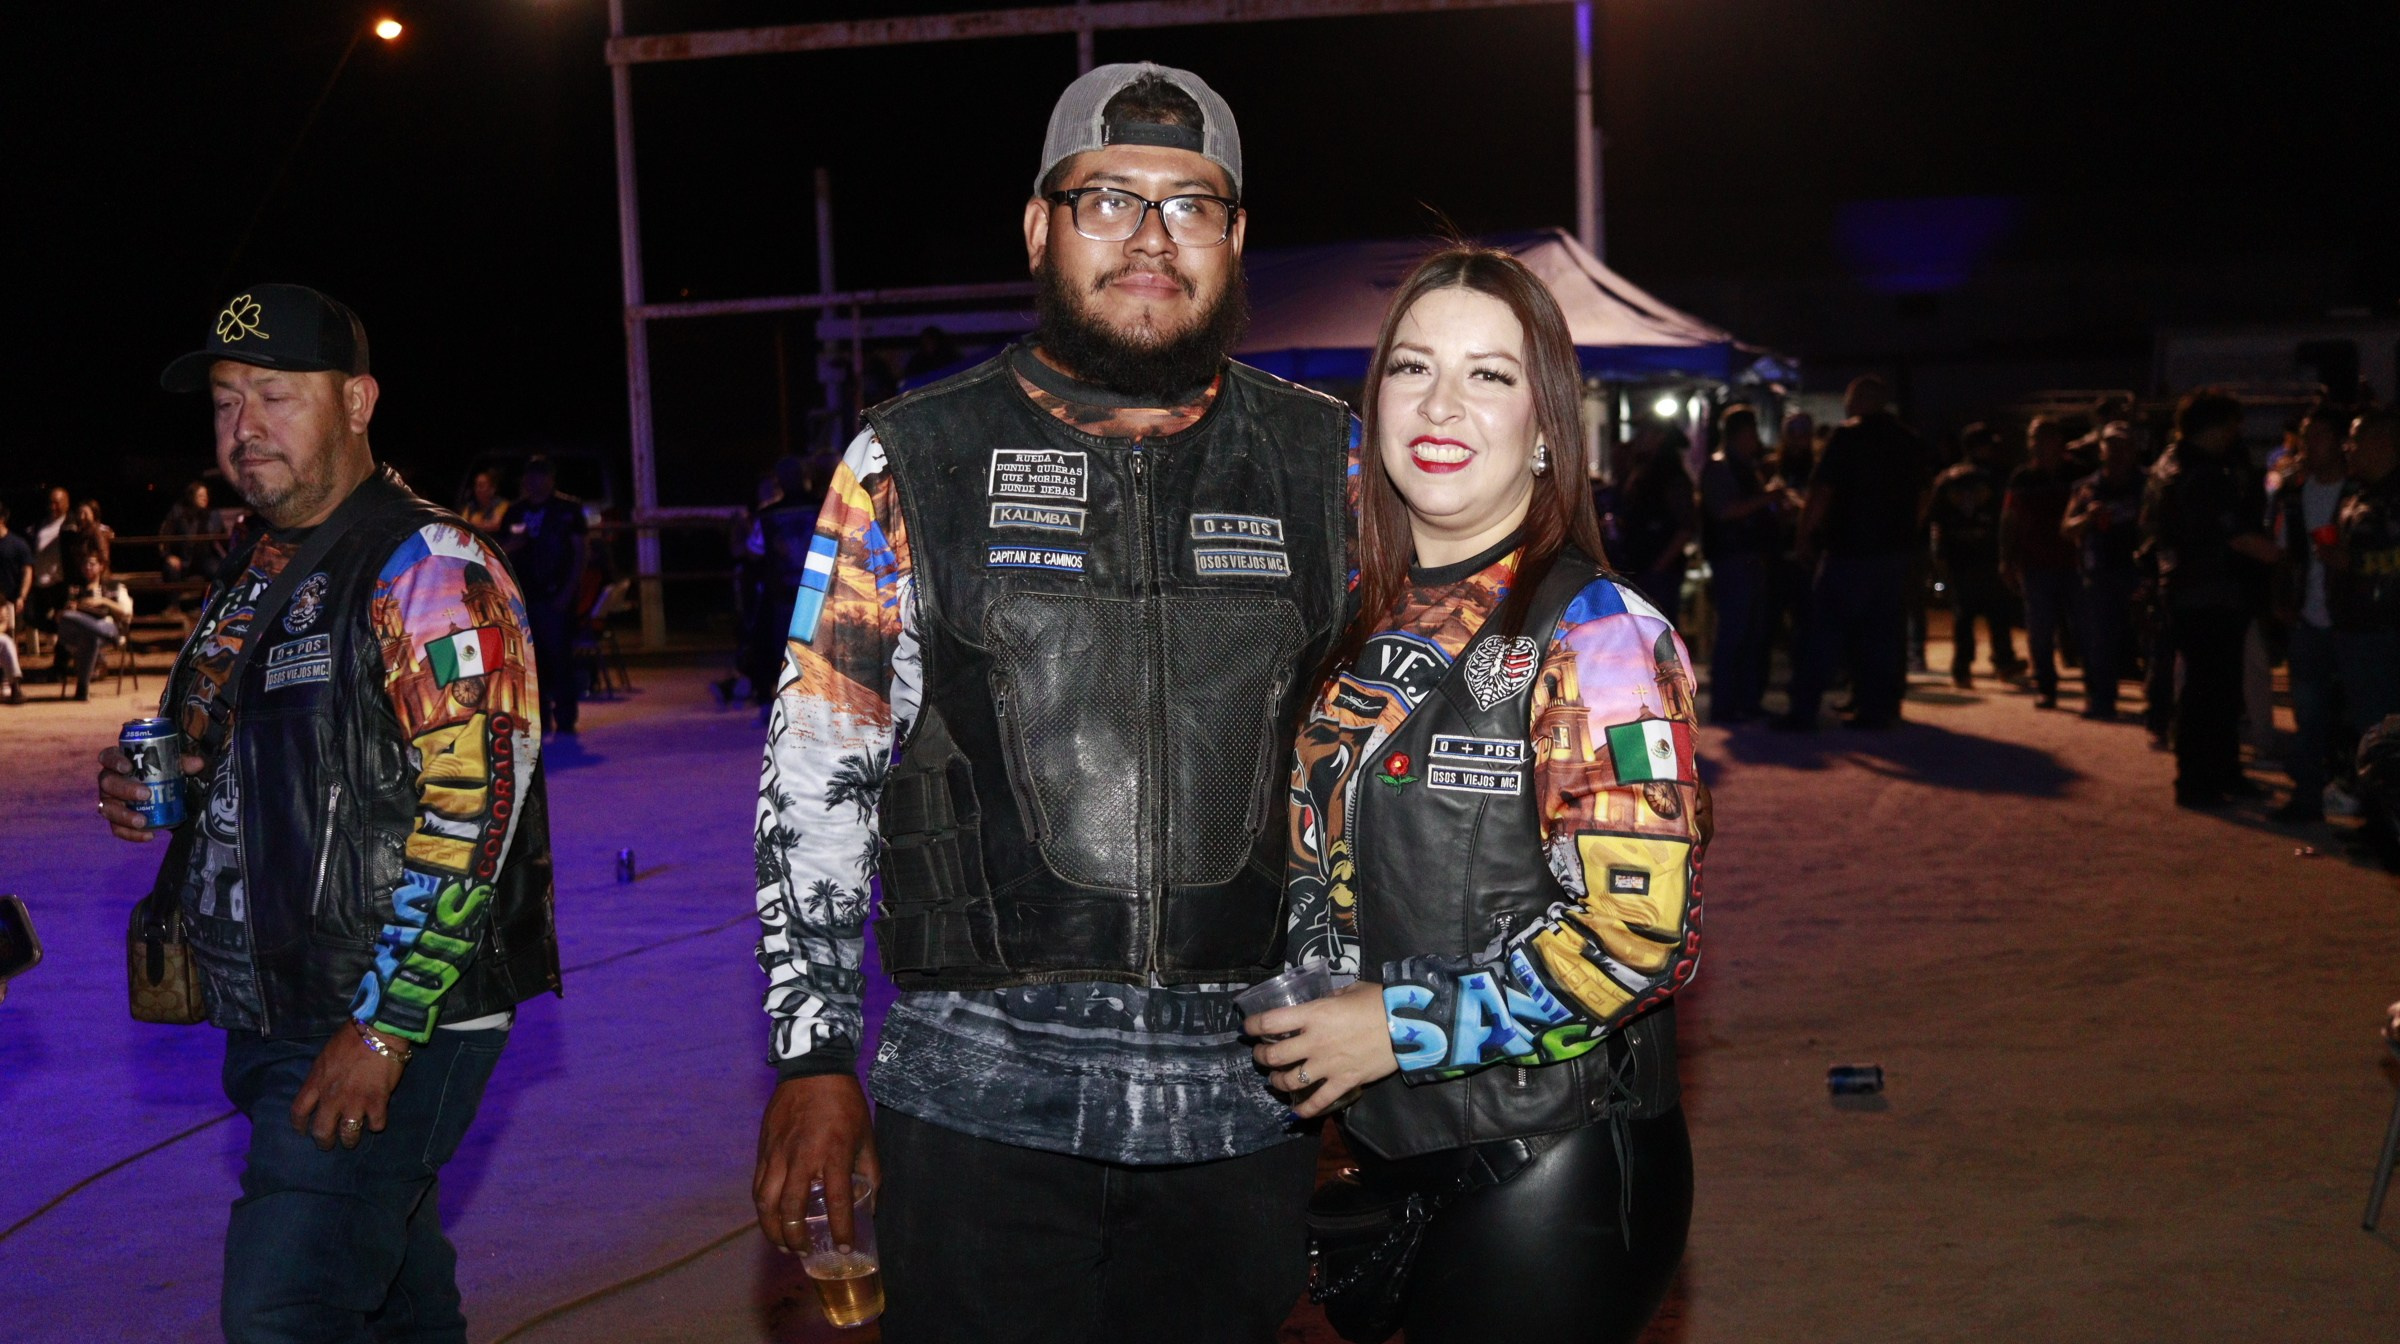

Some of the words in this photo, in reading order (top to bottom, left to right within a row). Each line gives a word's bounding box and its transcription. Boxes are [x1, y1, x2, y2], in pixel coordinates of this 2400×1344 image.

[1016, 454, 1051, 463] RUEDA
[1057, 455, 1065, 464] A
[997, 463, 1031, 473] DONDE
[1037, 464, 1082, 476] QUIERAS
[1002, 473, 1024, 482] QUE
[1028, 474, 1076, 485] MORIRAS
[1040, 485, 1076, 496] DEBAS
[1001, 508, 1071, 526] KALIMBA
[1238, 520, 1271, 536] POS
[989, 550, 1026, 563] CAPITAN
[1029, 551, 1041, 564] DE
[1044, 552, 1083, 568] CAMINOS
[1200, 555, 1229, 569] OSOS
[1229, 554, 1266, 569] VIEJOS
[297, 639, 321, 654] POS
[1484, 744, 1516, 757] POS
[1433, 771, 1457, 783] OSOS
[1463, 772, 1495, 787] VIEJOS
[477, 713, 515, 878] COLORADO
[1383, 948, 1575, 1073] SAN
